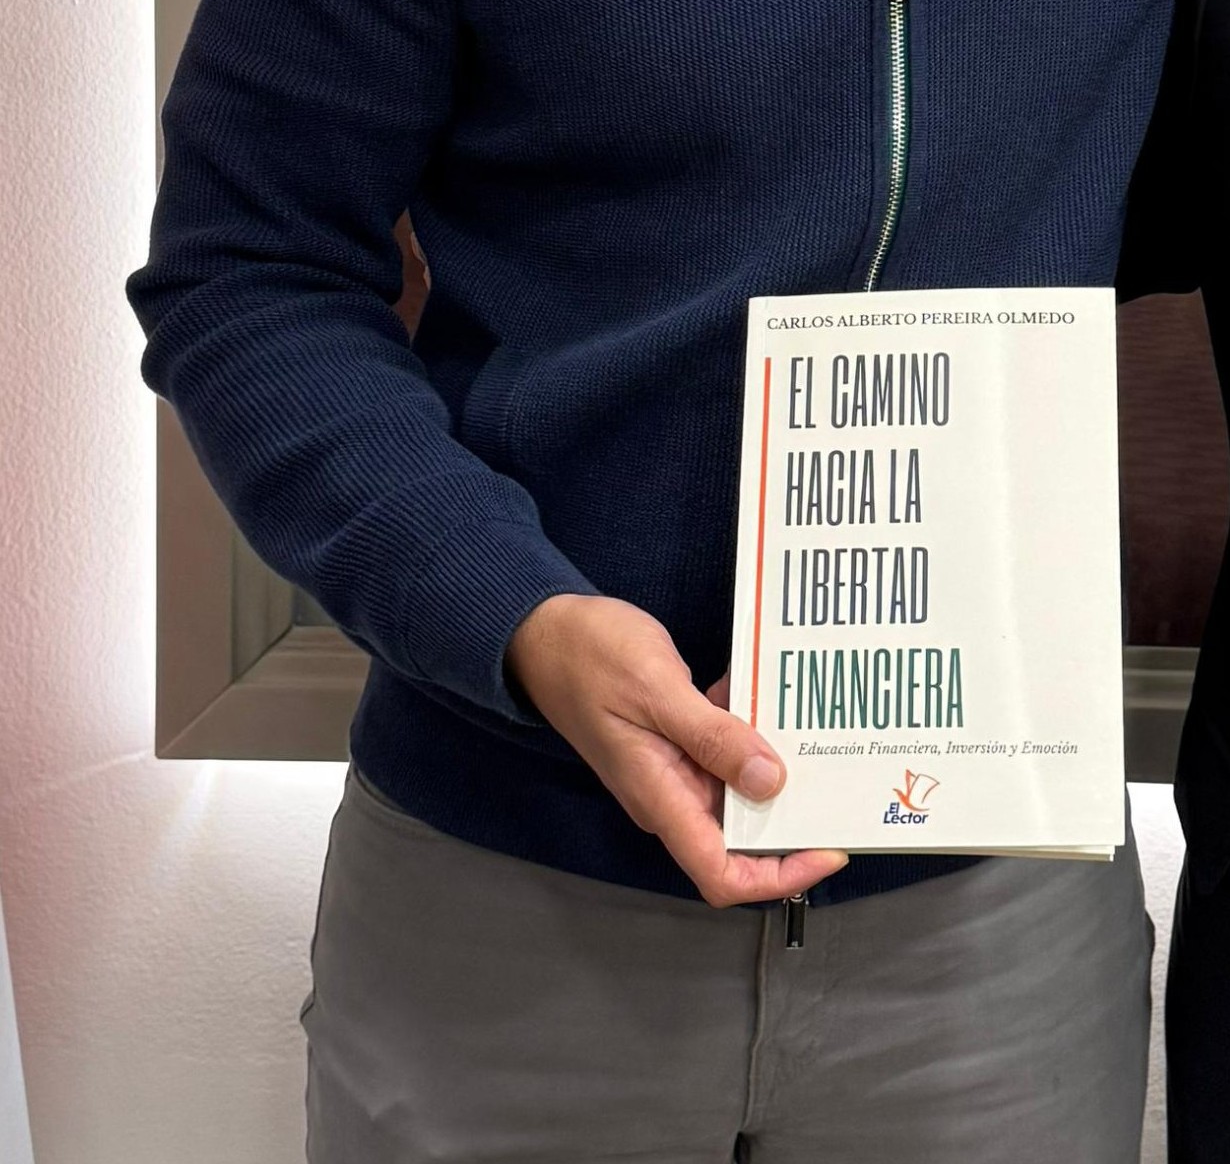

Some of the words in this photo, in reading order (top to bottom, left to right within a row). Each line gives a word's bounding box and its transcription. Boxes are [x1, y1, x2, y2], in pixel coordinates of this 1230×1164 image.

[766, 315, 834, 331] CARLOS
[836, 312, 917, 328] ALBERTO
[921, 311, 994, 325] PEREIRA
[996, 311, 1076, 325] OLMEDO
[789, 356, 816, 429] EL
[831, 352, 949, 429] CAMINO
[785, 449, 876, 526] HACIA
[889, 448, 921, 523] LA
[782, 547, 928, 626] LIBERTAD
[778, 648, 963, 730] FINANCIERA
[797, 741, 865, 756] Educación
[867, 739, 941, 756] Financiera,
[945, 740, 1007, 755] Inversión
[1008, 745, 1017, 757] y
[1020, 740, 1078, 755] Emoción
[883, 811, 929, 825] Lector
[889, 802, 900, 815] El
